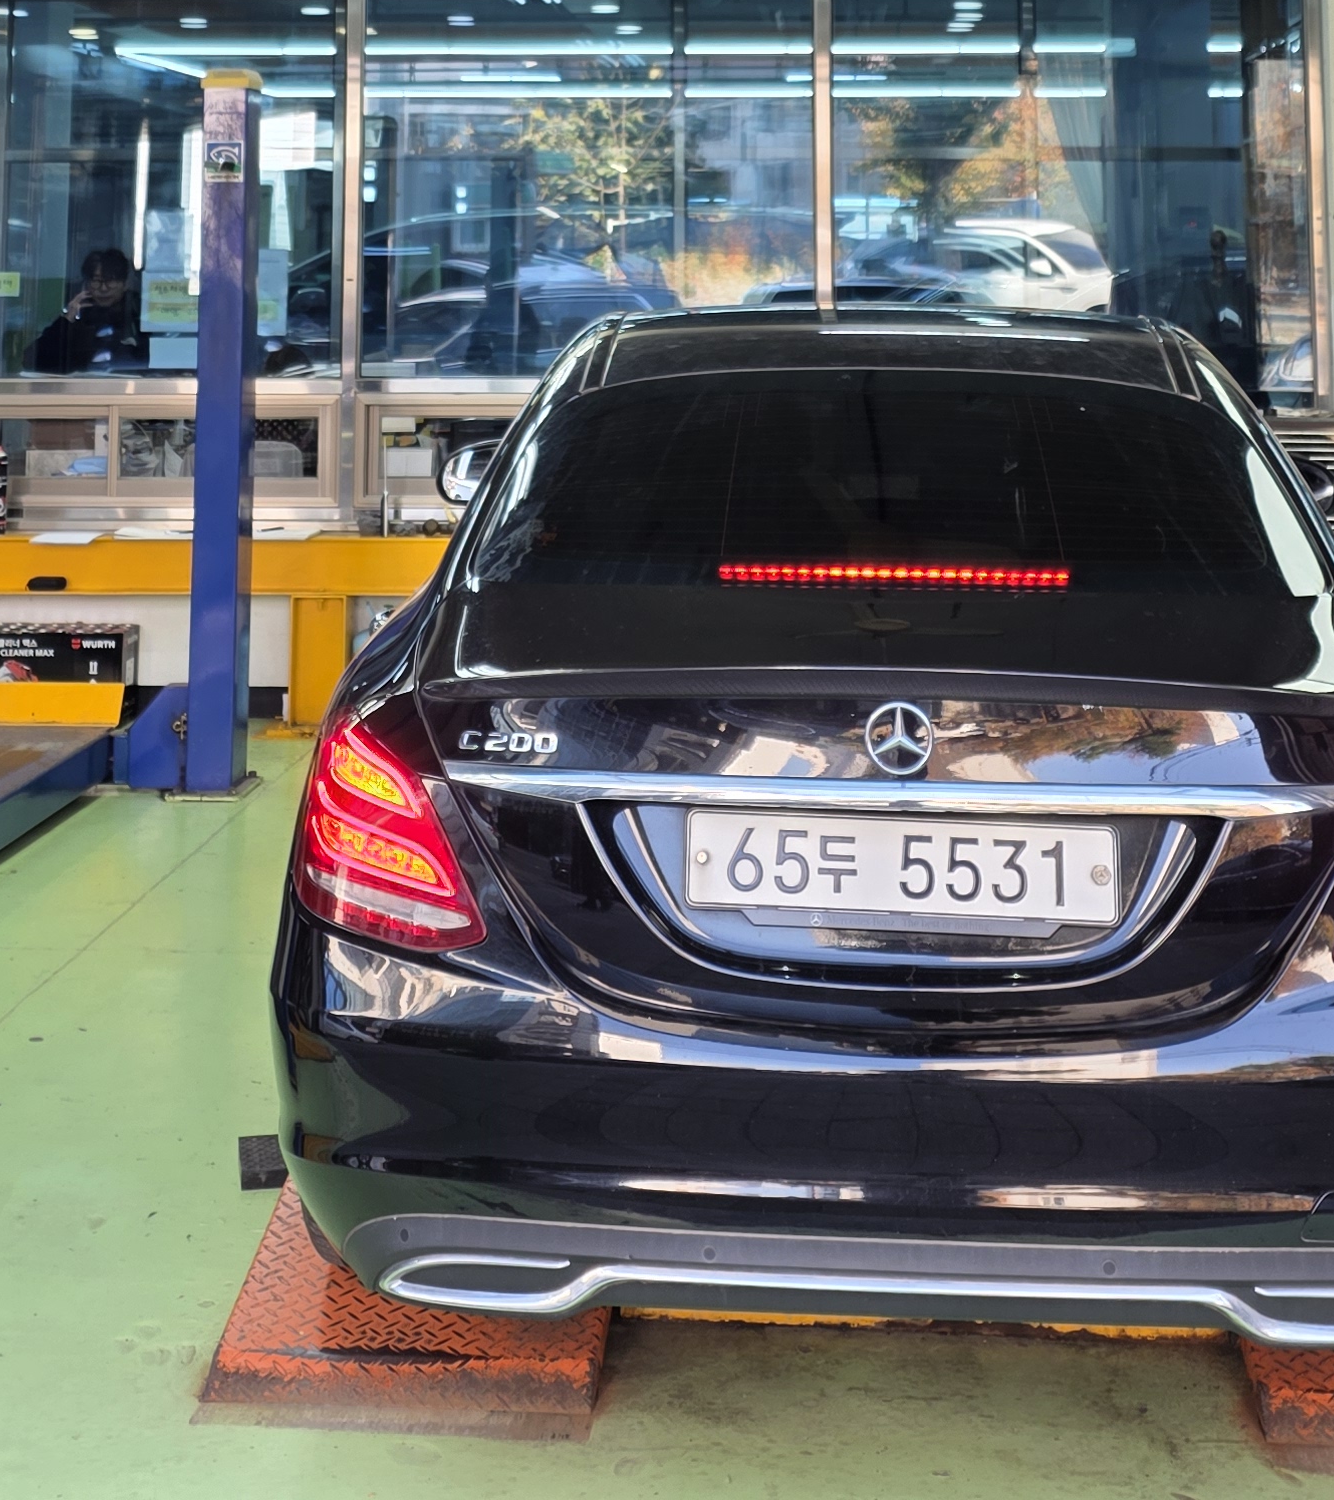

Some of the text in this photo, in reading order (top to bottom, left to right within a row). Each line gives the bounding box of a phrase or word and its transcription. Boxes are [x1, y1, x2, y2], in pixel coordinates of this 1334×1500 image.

[0, 649, 33, 657] CLEANER
[35, 649, 55, 658] MAX
[727, 827, 1065, 907] 65두 5531
